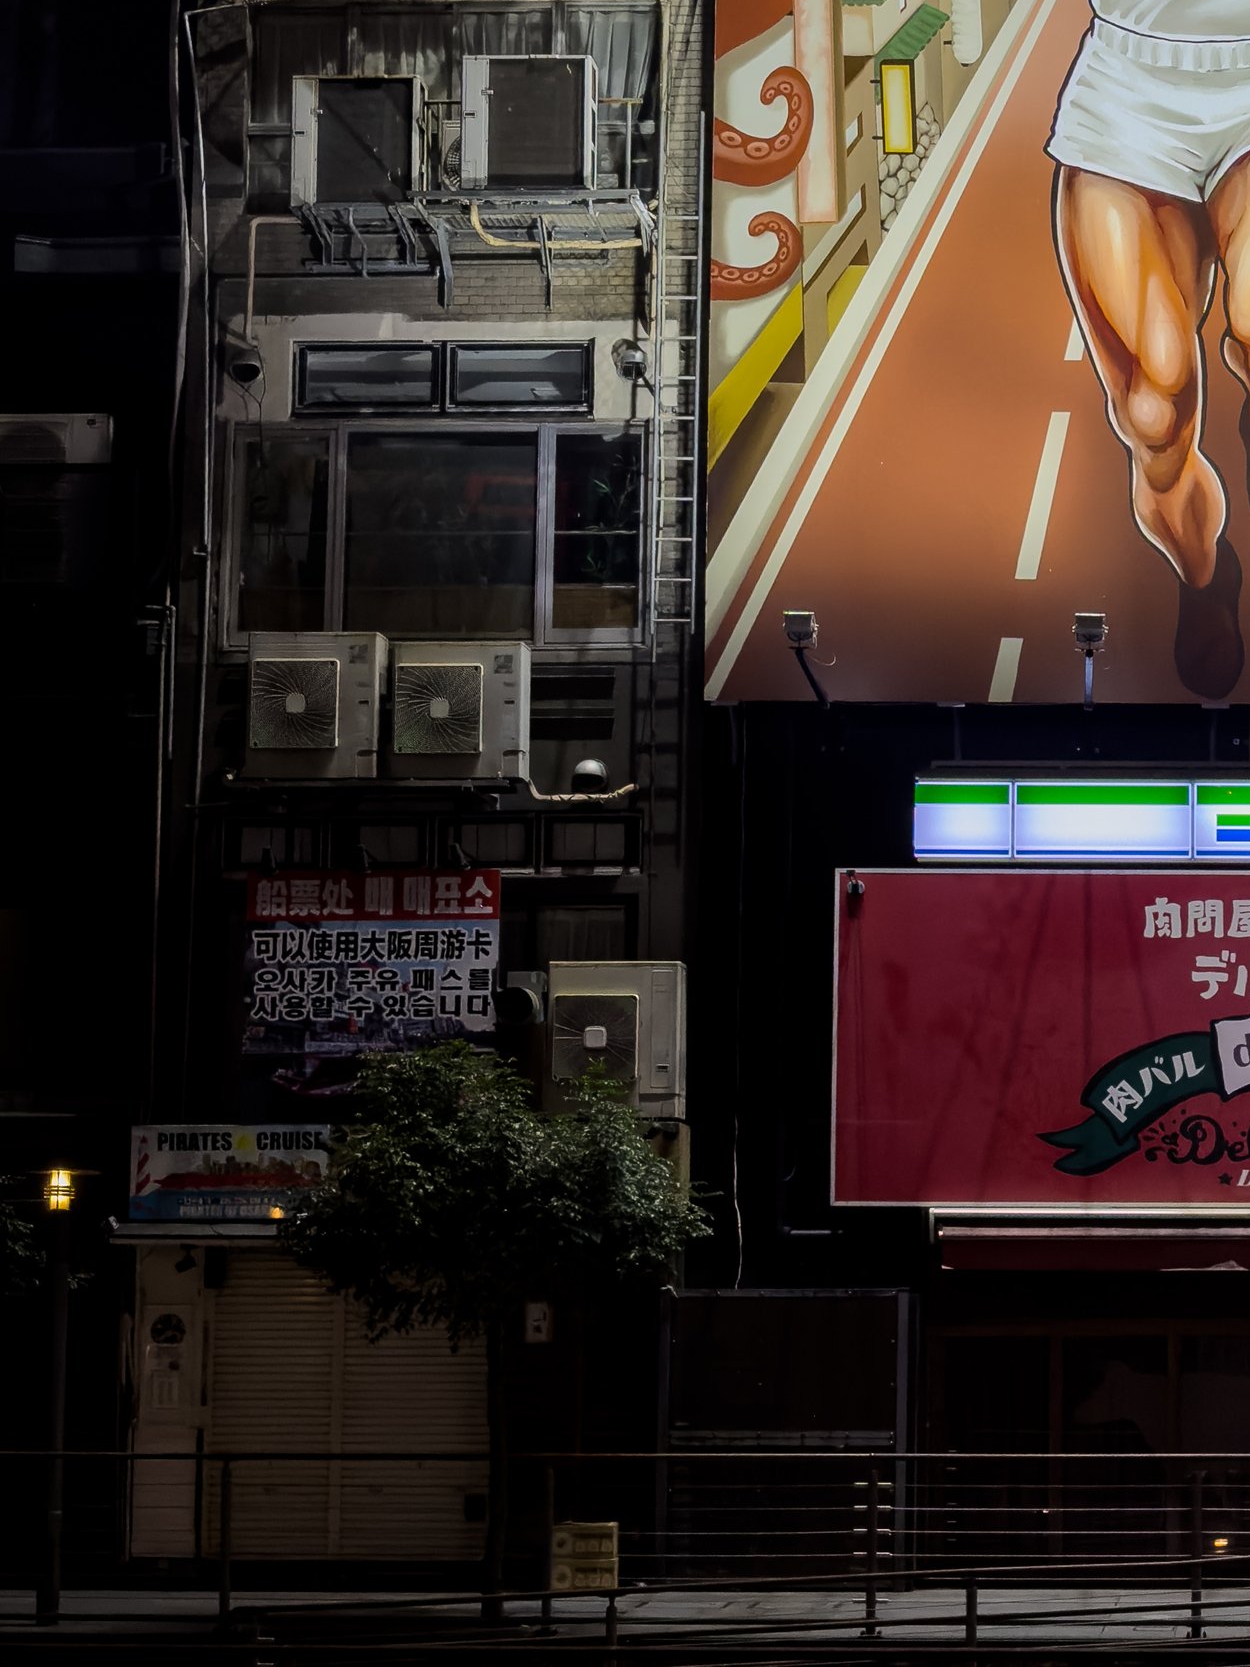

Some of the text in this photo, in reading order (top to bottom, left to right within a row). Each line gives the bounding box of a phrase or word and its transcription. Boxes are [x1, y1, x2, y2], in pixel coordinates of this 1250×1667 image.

[255, 878, 354, 917] 船票处
[253, 929, 493, 961] 可以使用大阪周游卡
[255, 968, 337, 993] 오사카
[348, 968, 401, 993] 주유
[253, 994, 491, 1020] 사용할 수 있습니다
[1101, 1050, 1207, 1123] 肉バル
[157, 1131, 322, 1151] PIRATES CRUISE
